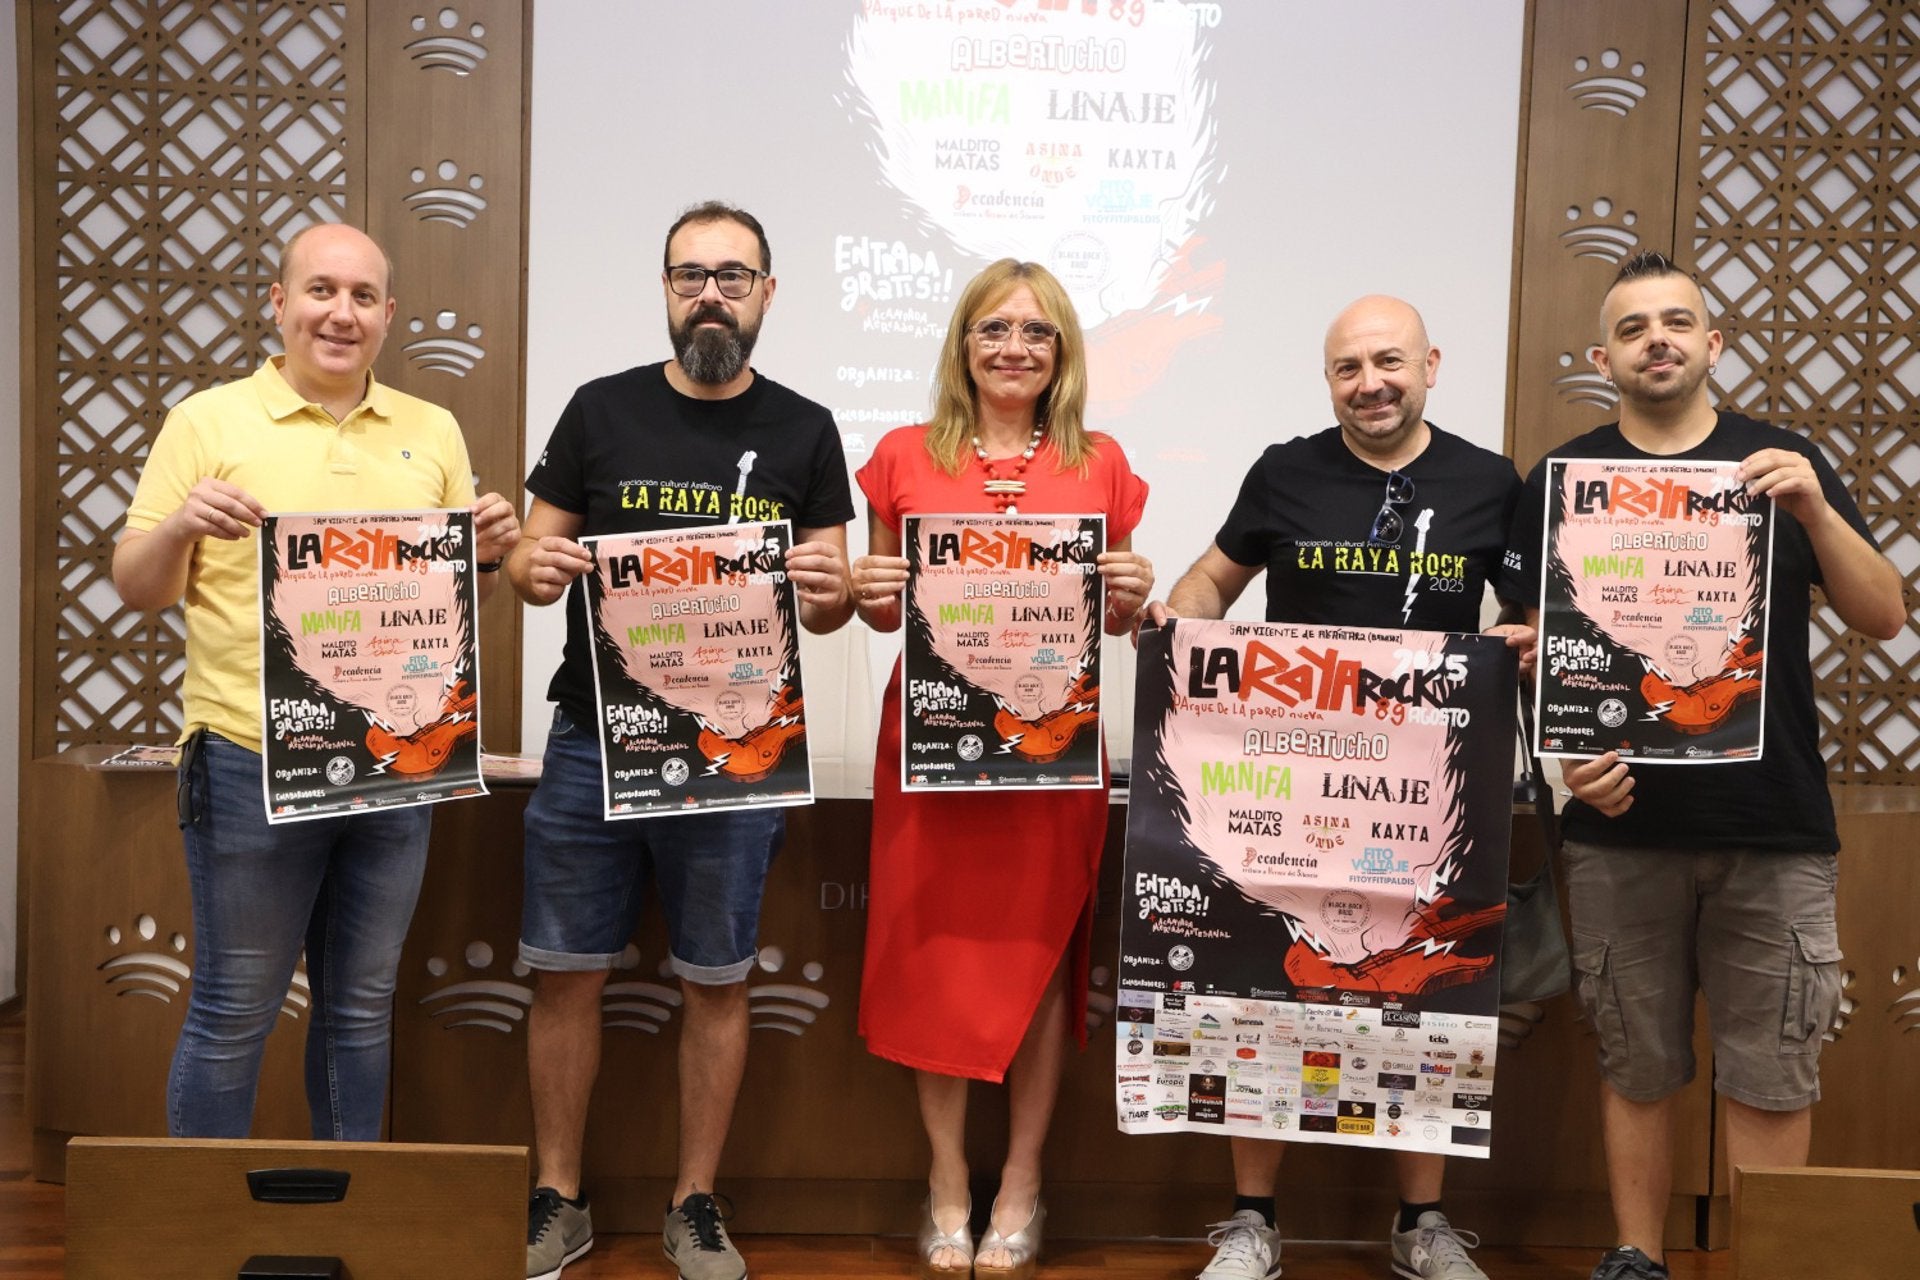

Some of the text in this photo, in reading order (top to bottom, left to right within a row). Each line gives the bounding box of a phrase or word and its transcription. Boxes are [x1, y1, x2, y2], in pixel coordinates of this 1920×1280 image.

[1046, 89, 1176, 124] LINAJE
[935, 139, 1000, 152] MALDITO
[1025, 142, 1083, 157] ASINA
[935, 153, 1000, 171] MATAS
[1108, 148, 1176, 170] KAXTA
[1030, 165, 1076, 184] ONDE
[660, 480, 689, 488] cultural
[621, 486, 784, 521] LA RAYA ROCK
[1574, 480, 1609, 514] LA
[288, 533, 322, 570] LA
[929, 533, 960, 565] LA
[1335, 540, 1365, 548] cultural
[1298, 547, 1467, 578] LA RAYA ROCK
[1583, 554, 1737, 579] MANIFA LINAJE
[609, 554, 643, 589] LA
[1429, 577, 1464, 593] 2025
[1602, 594, 1638, 603] MATAS
[1698, 590, 1737, 603] KAXTA
[938, 603, 1075, 625] MANIFA LINAJE
[301, 608, 447, 636] MANIFA LINAJE
[627, 618, 769, 648] MANIFA LINAJE
[1041, 633, 1075, 643] KAXTA
[1229, 625, 1250, 636] SAN
[1253, 626, 1298, 638] VICENTE
[321, 640, 356, 649] MALDITO
[412, 638, 449, 649] KAXTA
[956, 638, 989, 647] MATAS
[321, 648, 357, 659] MATAS
[649, 650, 683, 660] MALDITO
[737, 646, 773, 658] KAXTA
[650, 658, 684, 669] MATAS
[1188, 647, 1239, 698] LA
[1233, 702, 1246, 717] LA
[1407, 707, 1470, 728] AGOSTO
[1201, 761, 1430, 805] MANIFA LINAJE
[1229, 809, 1283, 823] MALDITO
[1302, 814, 1350, 829] ASINA
[1228, 821, 1282, 837] MATAS
[1371, 822, 1429, 843] KAXTA
[1305, 833, 1345, 849] ONDE
[1364, 847, 1393, 860] FITO
[1352, 859, 1409, 872] VOLTAJE
[1135, 872, 1201, 901] ENTRADA
[1349, 875, 1415, 885] FITOYFITIPALDIS
[1420, 1063, 1452, 1074] BigMat
